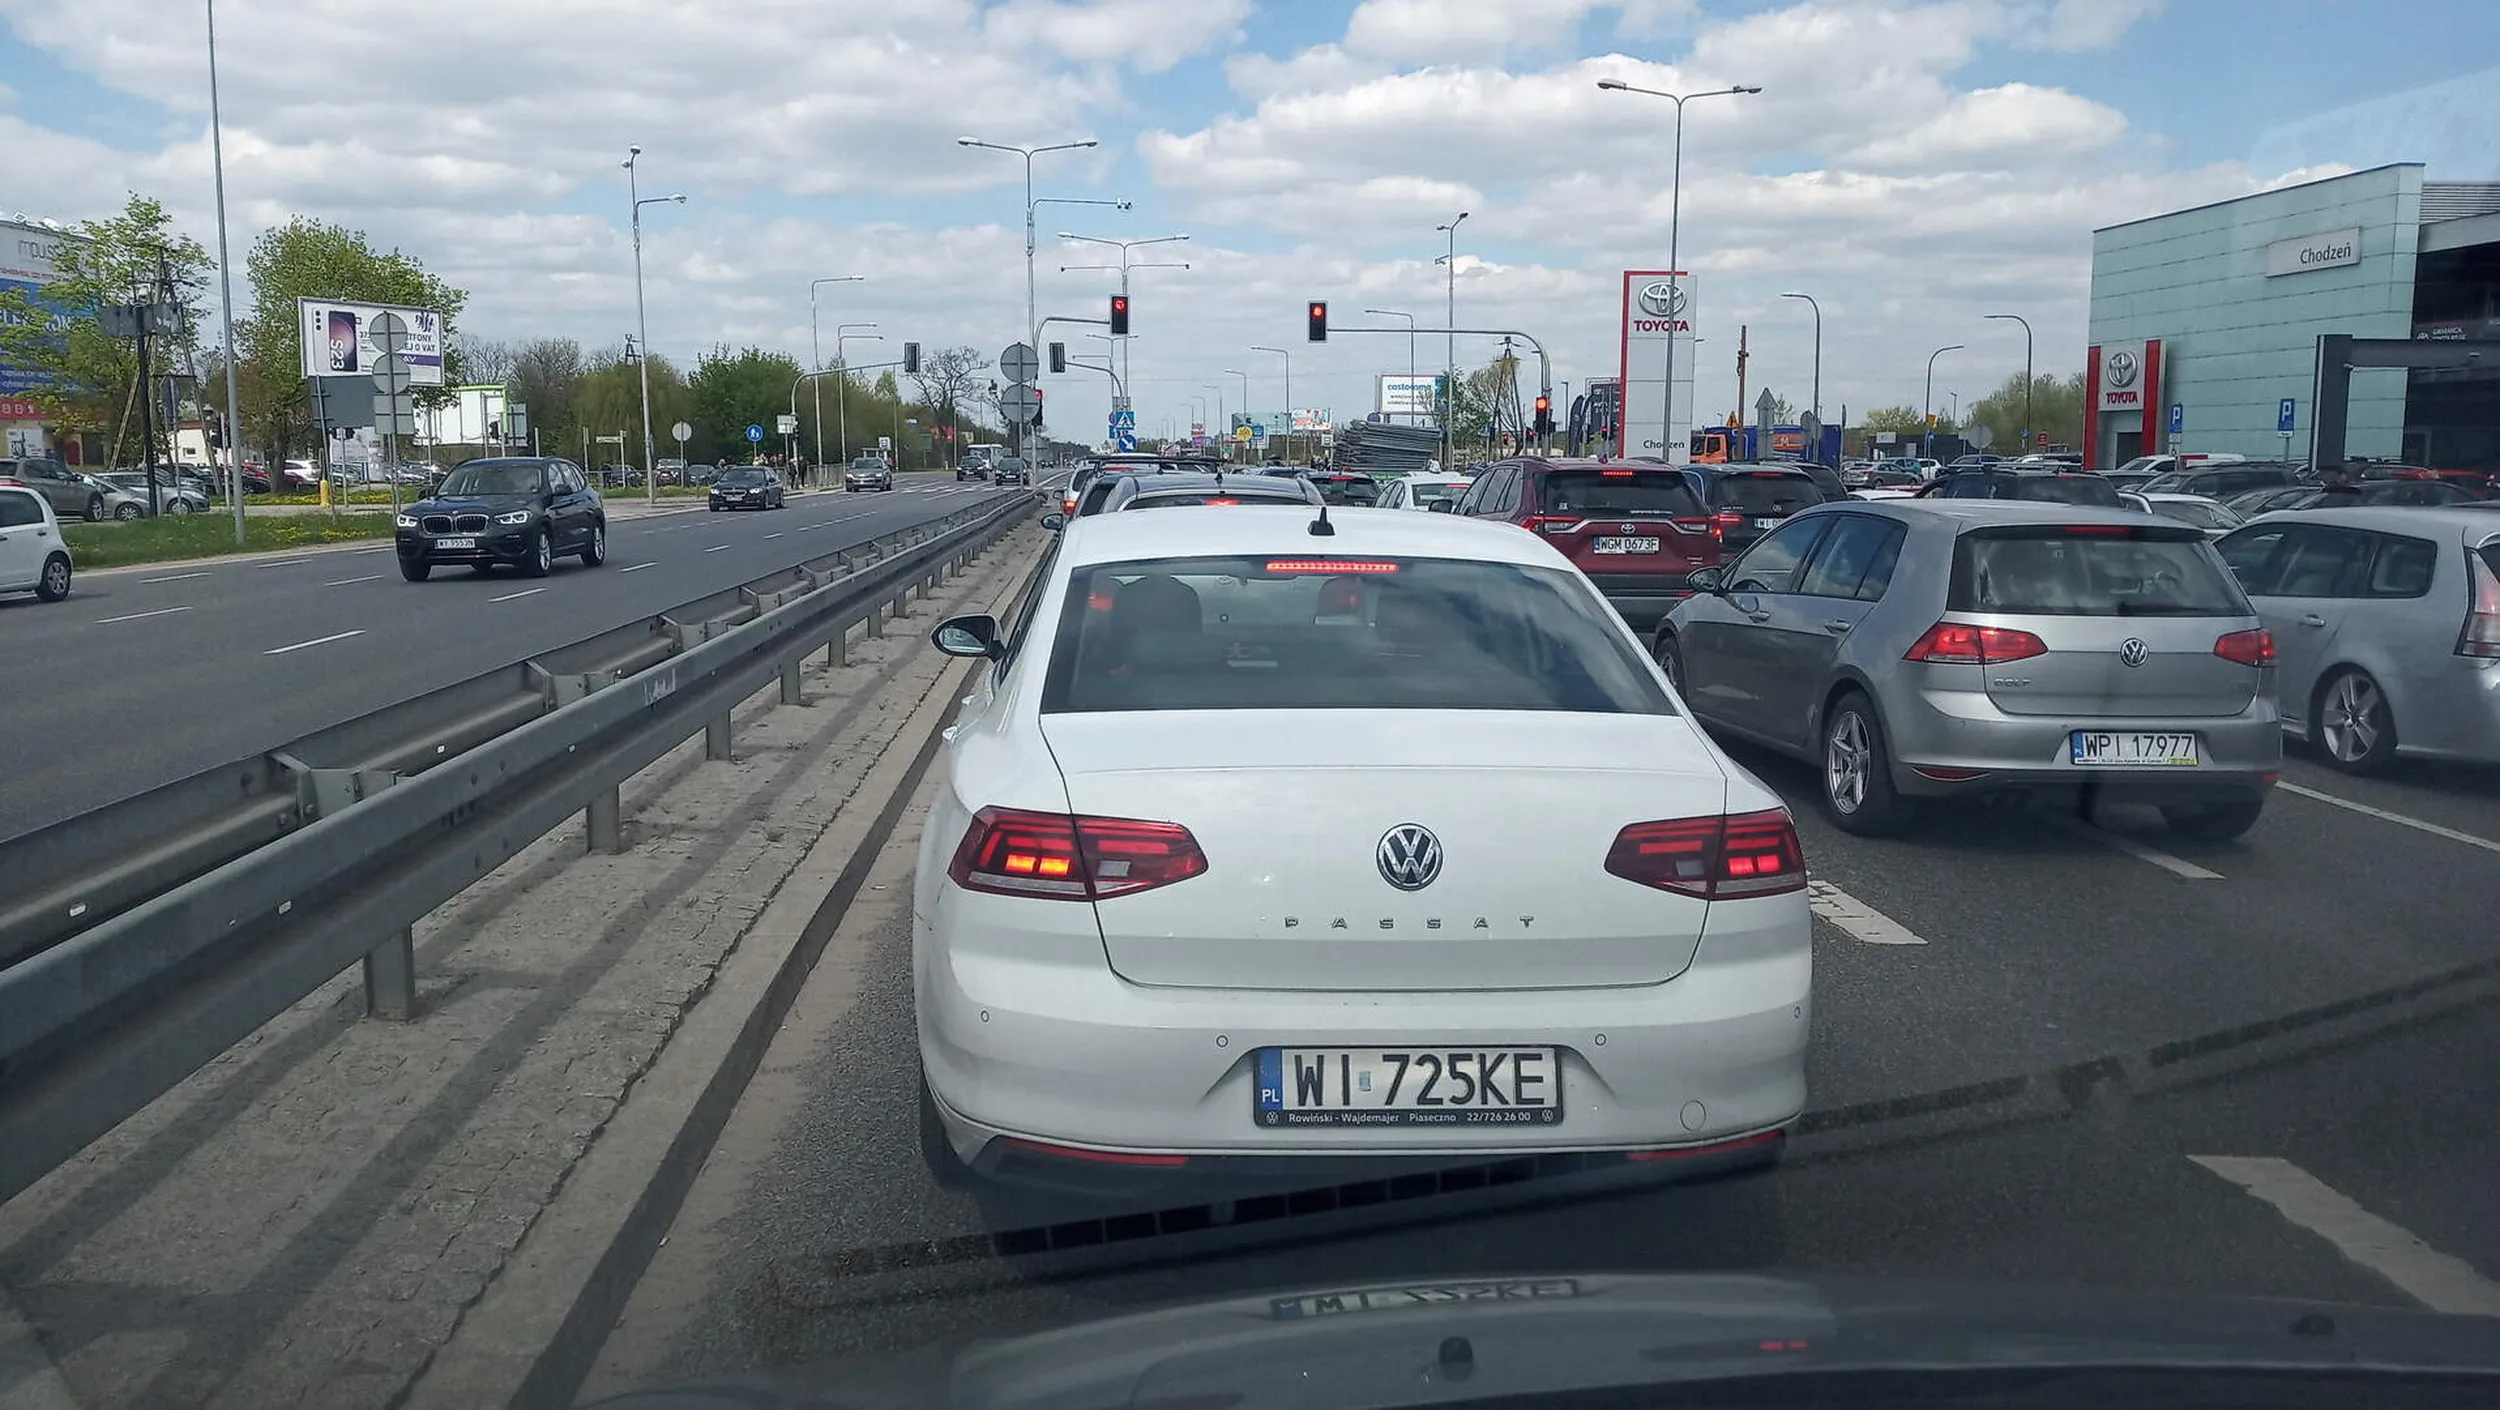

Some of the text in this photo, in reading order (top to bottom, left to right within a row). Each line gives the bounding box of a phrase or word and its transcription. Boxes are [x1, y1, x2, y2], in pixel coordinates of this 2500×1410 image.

[2300, 241, 2351, 264] Chodzeń
[1633, 320, 1690, 332] TOYOTA
[331, 339, 345, 370] S23
[2106, 391, 2138, 404] TOYOTA
[2085, 735, 2193, 758] WPI 17977
[1284, 915, 1534, 930] PASSAT
[1294, 1052, 1545, 1107] WI 725KE
[1262, 1089, 1280, 1103] PL
[1288, 1111, 1333, 1123] Rowiński
[1341, 1111, 1400, 1124] Wajdemajer
[1409, 1112, 1457, 1122] Piaseczno
[1466, 1111, 1502, 1122] 22/726
[1504, 1111, 1516, 1122] 26
[1518, 1111, 1531, 1122] 00
